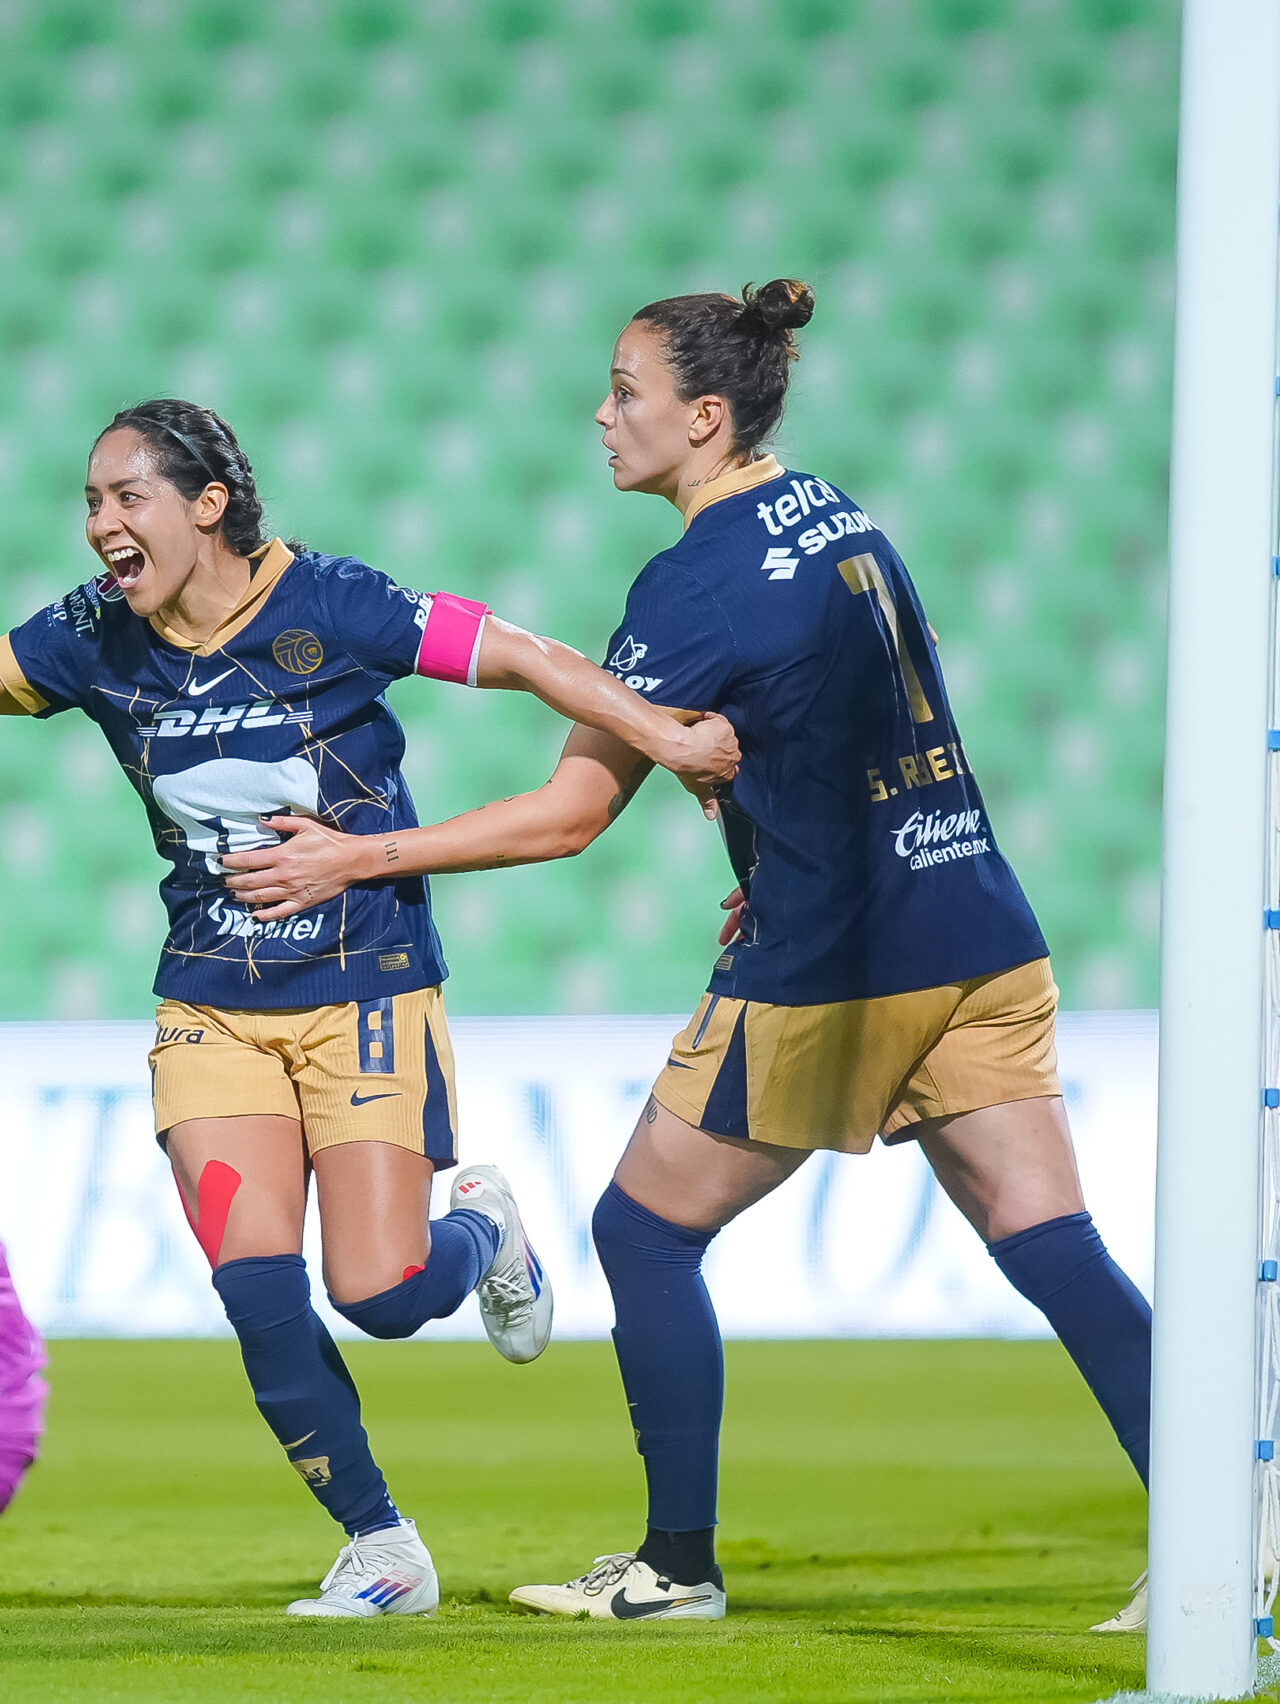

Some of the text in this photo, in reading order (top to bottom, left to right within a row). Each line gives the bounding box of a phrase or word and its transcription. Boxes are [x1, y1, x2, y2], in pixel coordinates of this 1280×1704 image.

[797, 510, 880, 555] SUZUK
[836, 552, 933, 723] 7
[152, 699, 287, 738] DHL
[866, 767, 899, 803] S.
[357, 996, 396, 1074] 8
